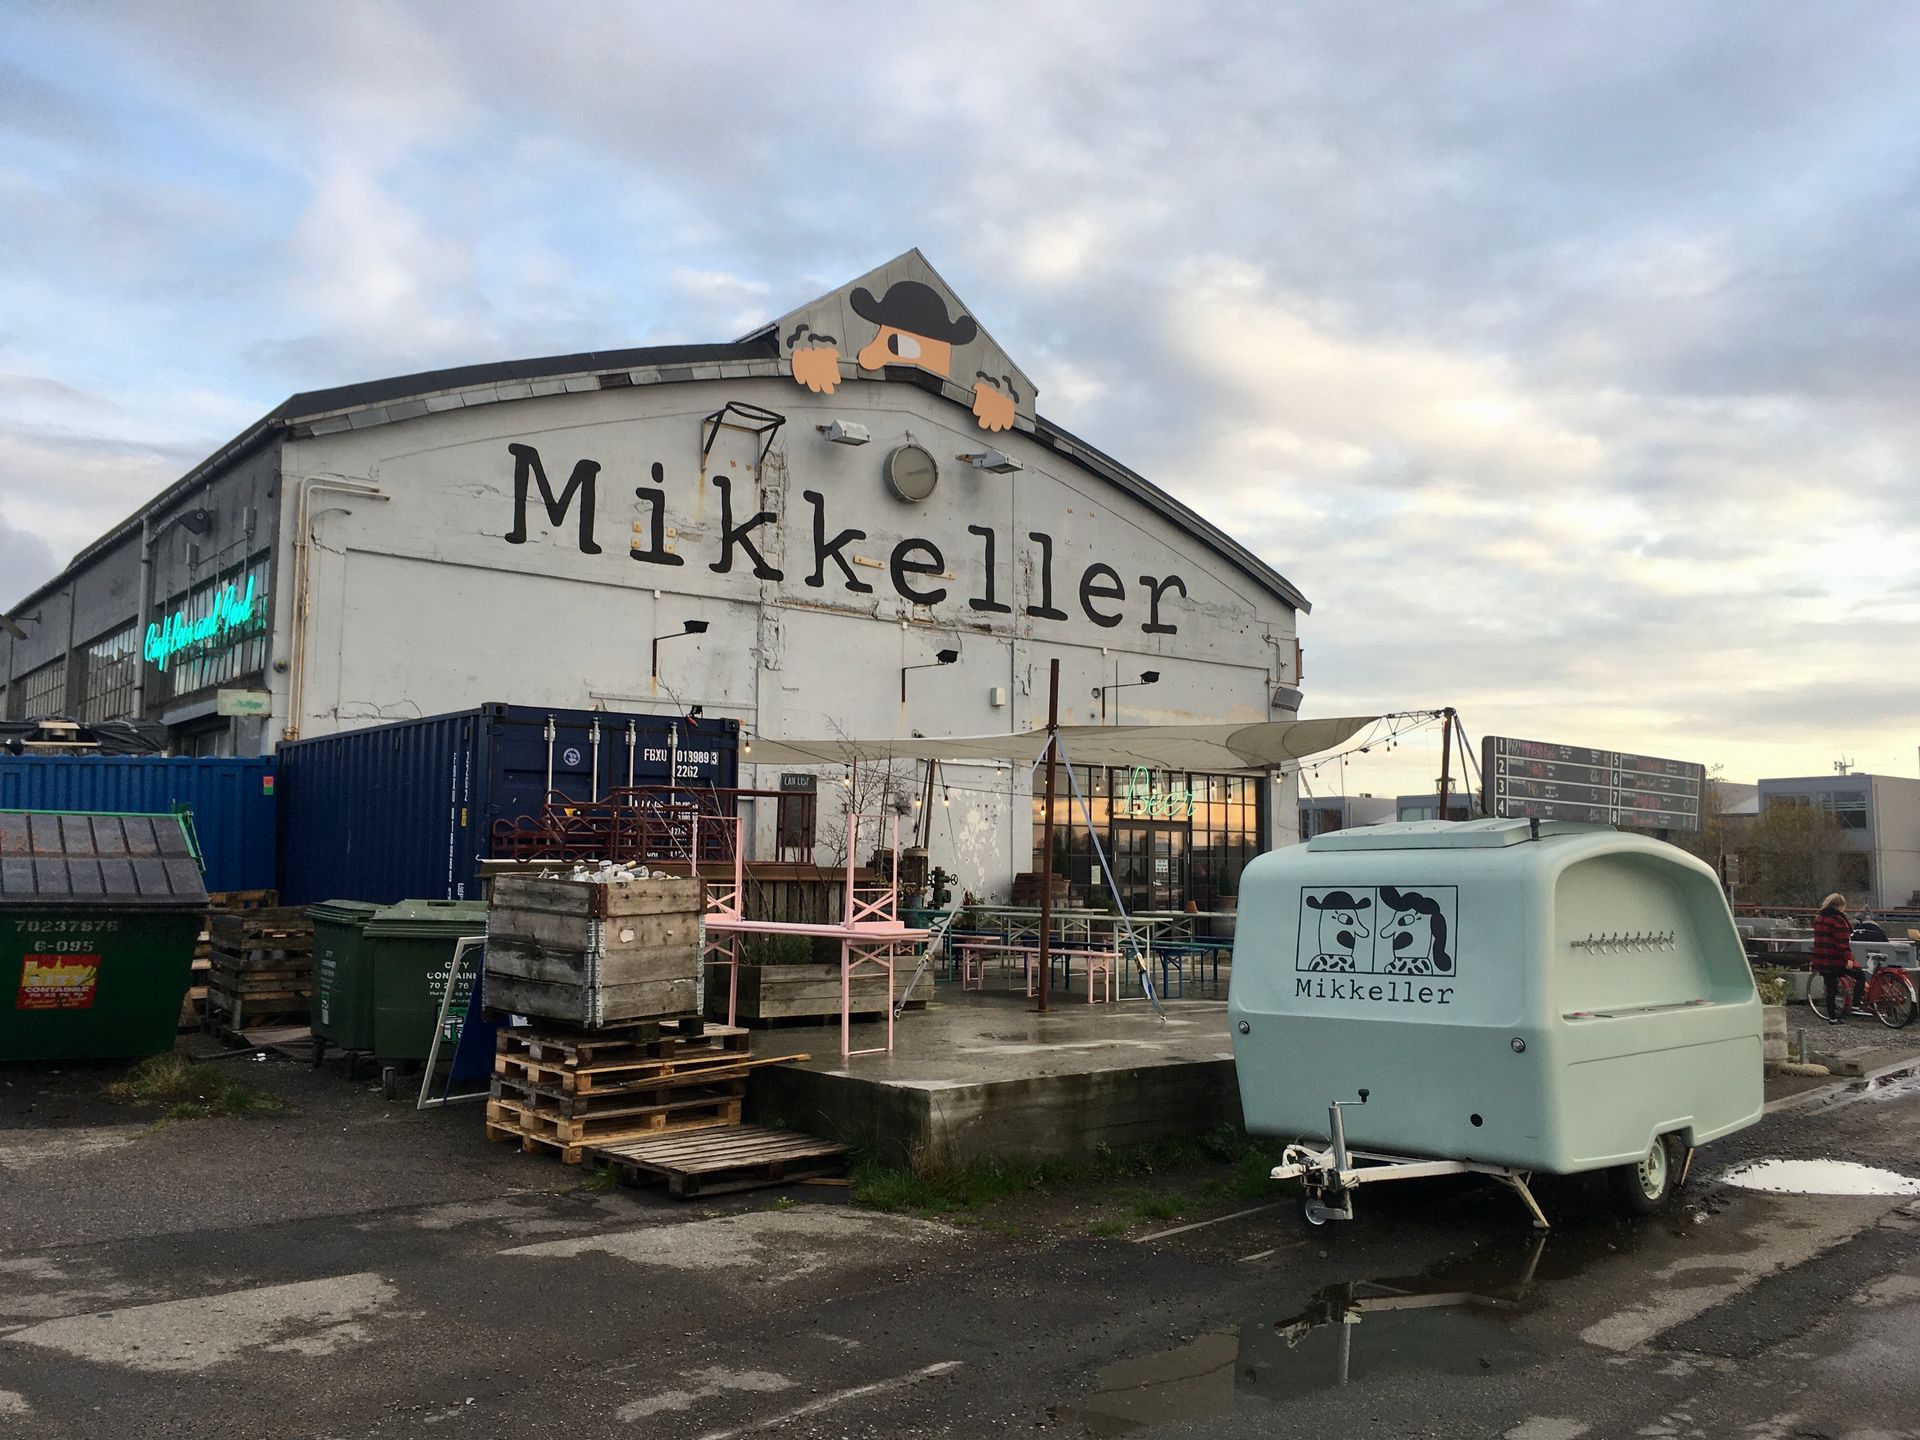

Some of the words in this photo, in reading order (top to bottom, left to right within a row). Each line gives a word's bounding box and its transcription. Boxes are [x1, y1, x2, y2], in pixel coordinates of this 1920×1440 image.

[504, 442, 1187, 635] Mikkeller
[1499, 739, 1504, 752] 1
[644, 748, 668, 762] FBXU
[676, 750, 710, 764] 018989
[711, 752, 718, 765] 3
[1614, 754, 1619, 766] 5
[676, 765, 699, 778] 22G2
[1498, 760, 1505, 773] 2
[784, 776, 797, 786] CAN
[1613, 773, 1618, 785] 6
[1122, 765, 1197, 817] Beer
[1498, 780, 1505, 793] 3
[1613, 792, 1618, 803] 7
[1498, 800, 1505, 813] 4
[1612, 811, 1617, 823] 8
[34, 940, 94, 952] 6-095
[458, 982, 470, 990] 76
[1295, 977, 1454, 1004] Mikkeller
